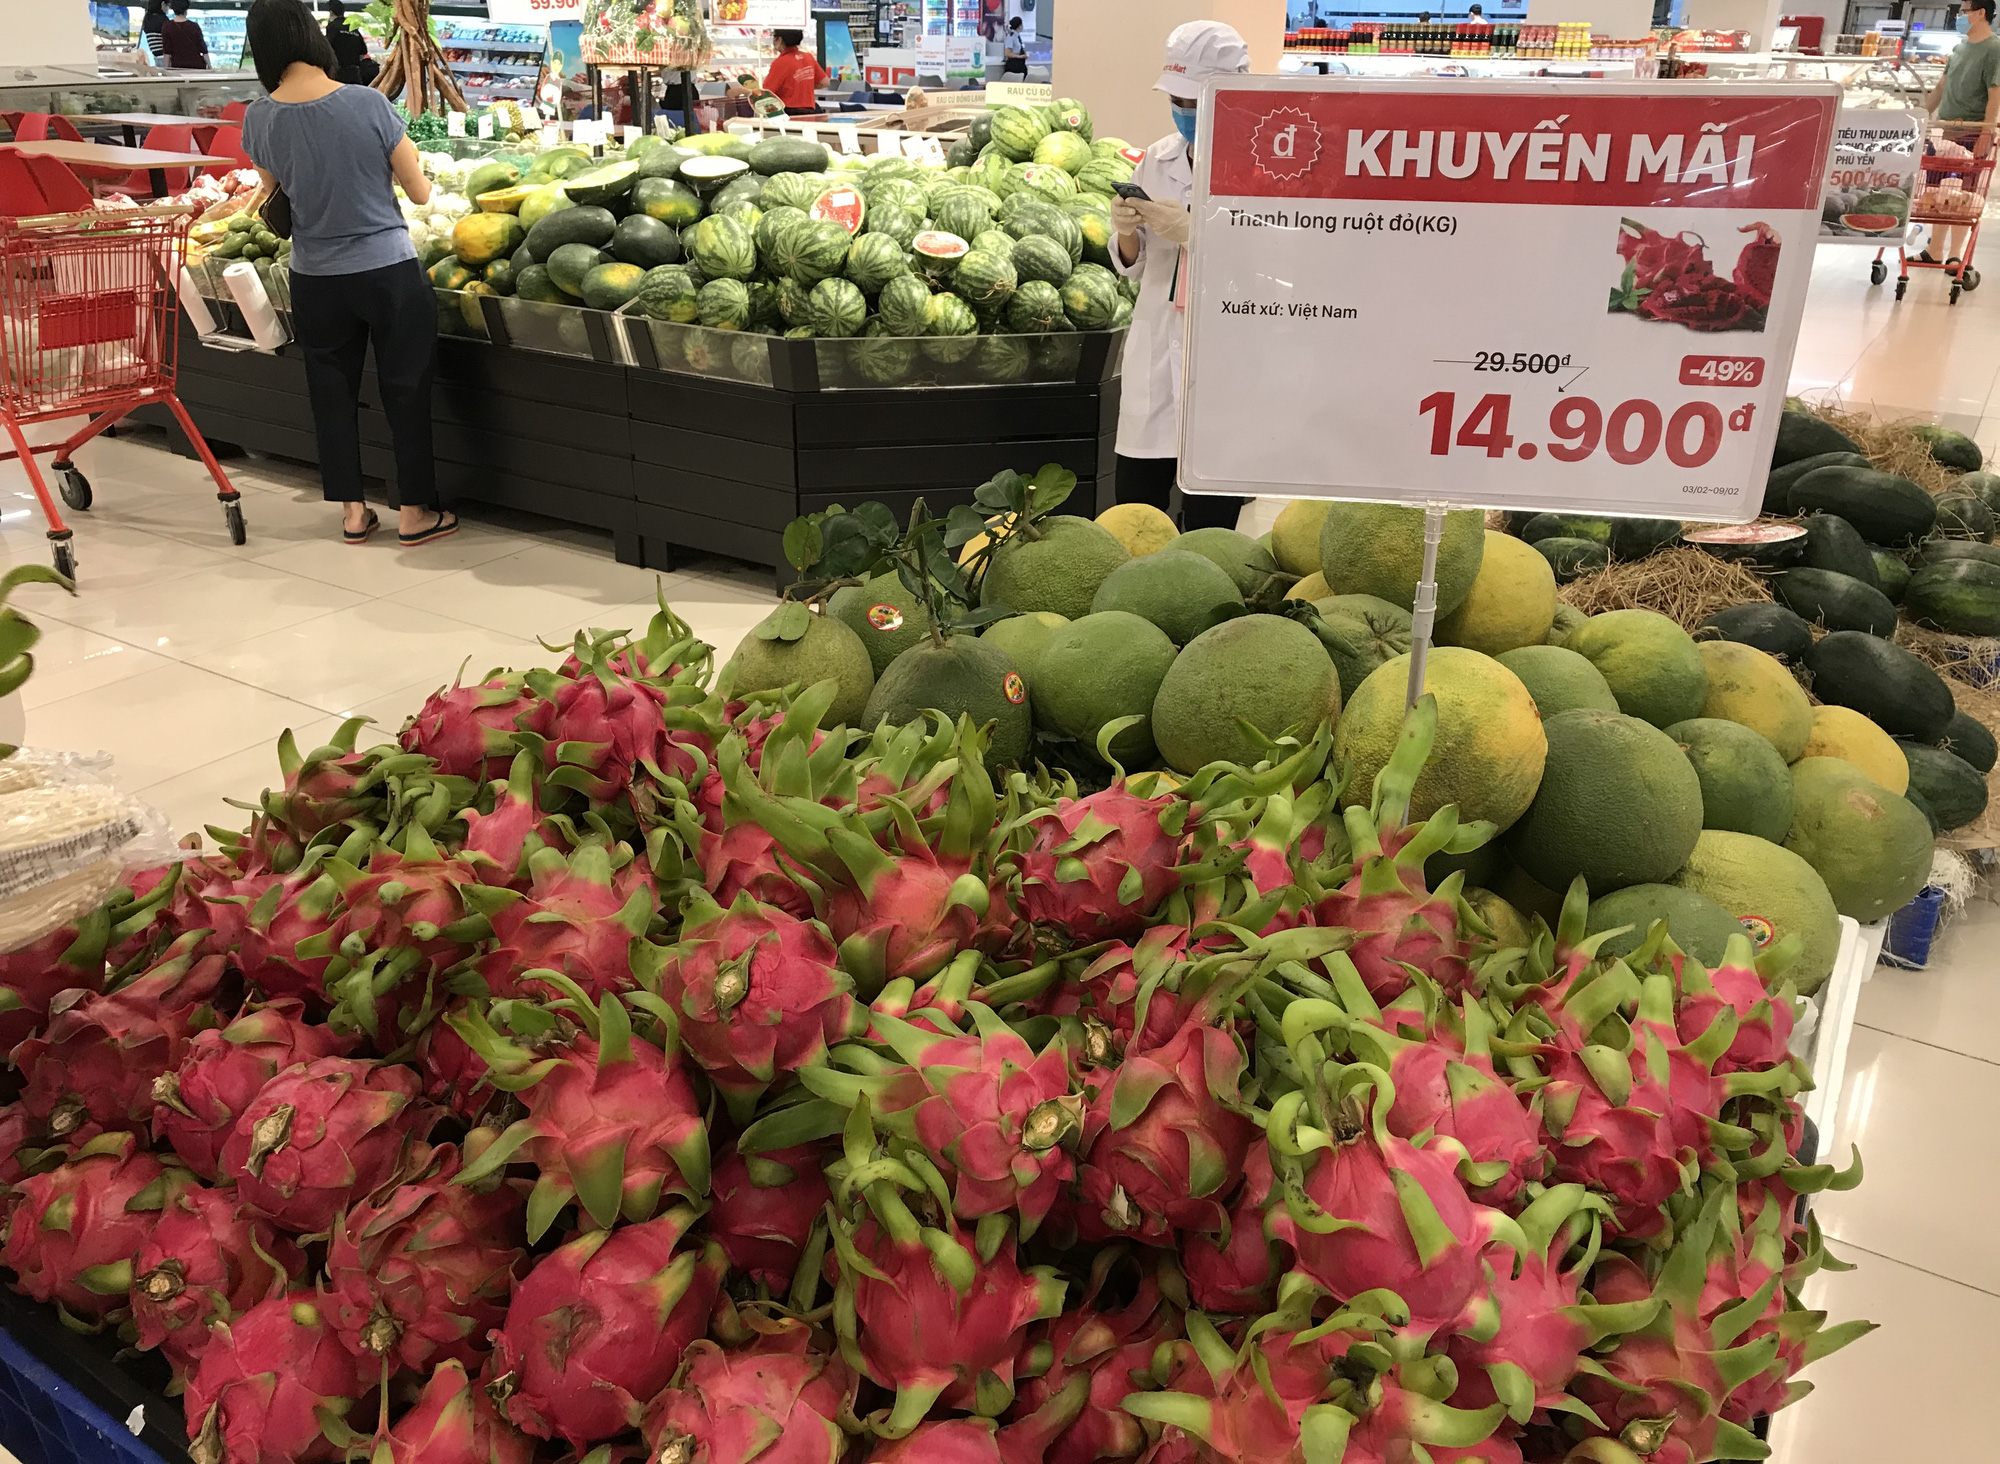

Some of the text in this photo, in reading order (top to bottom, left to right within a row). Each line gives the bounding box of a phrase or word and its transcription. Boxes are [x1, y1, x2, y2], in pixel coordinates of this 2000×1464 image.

[530, 0, 579, 10] 59.90
[1007, 87, 1024, 95] RAU
[1838, 127, 1857, 139] TIÊU
[1860, 129, 1877, 141] THỤ
[1879, 129, 1899, 139] DƯA
[1345, 114, 1611, 182] KHUYẾN
[1625, 122, 1756, 185] MÃI
[1835, 153, 1875, 165] PHÚ YÊN
[1229, 209, 1458, 236] Thanh long ruột đỏ(KG)
[1221, 299, 1358, 320] Xuất xứ: Việt Nam
[1690, 360, 1756, 382] -49%
[1682, 485, 1739, 496] 03/02~09/02
